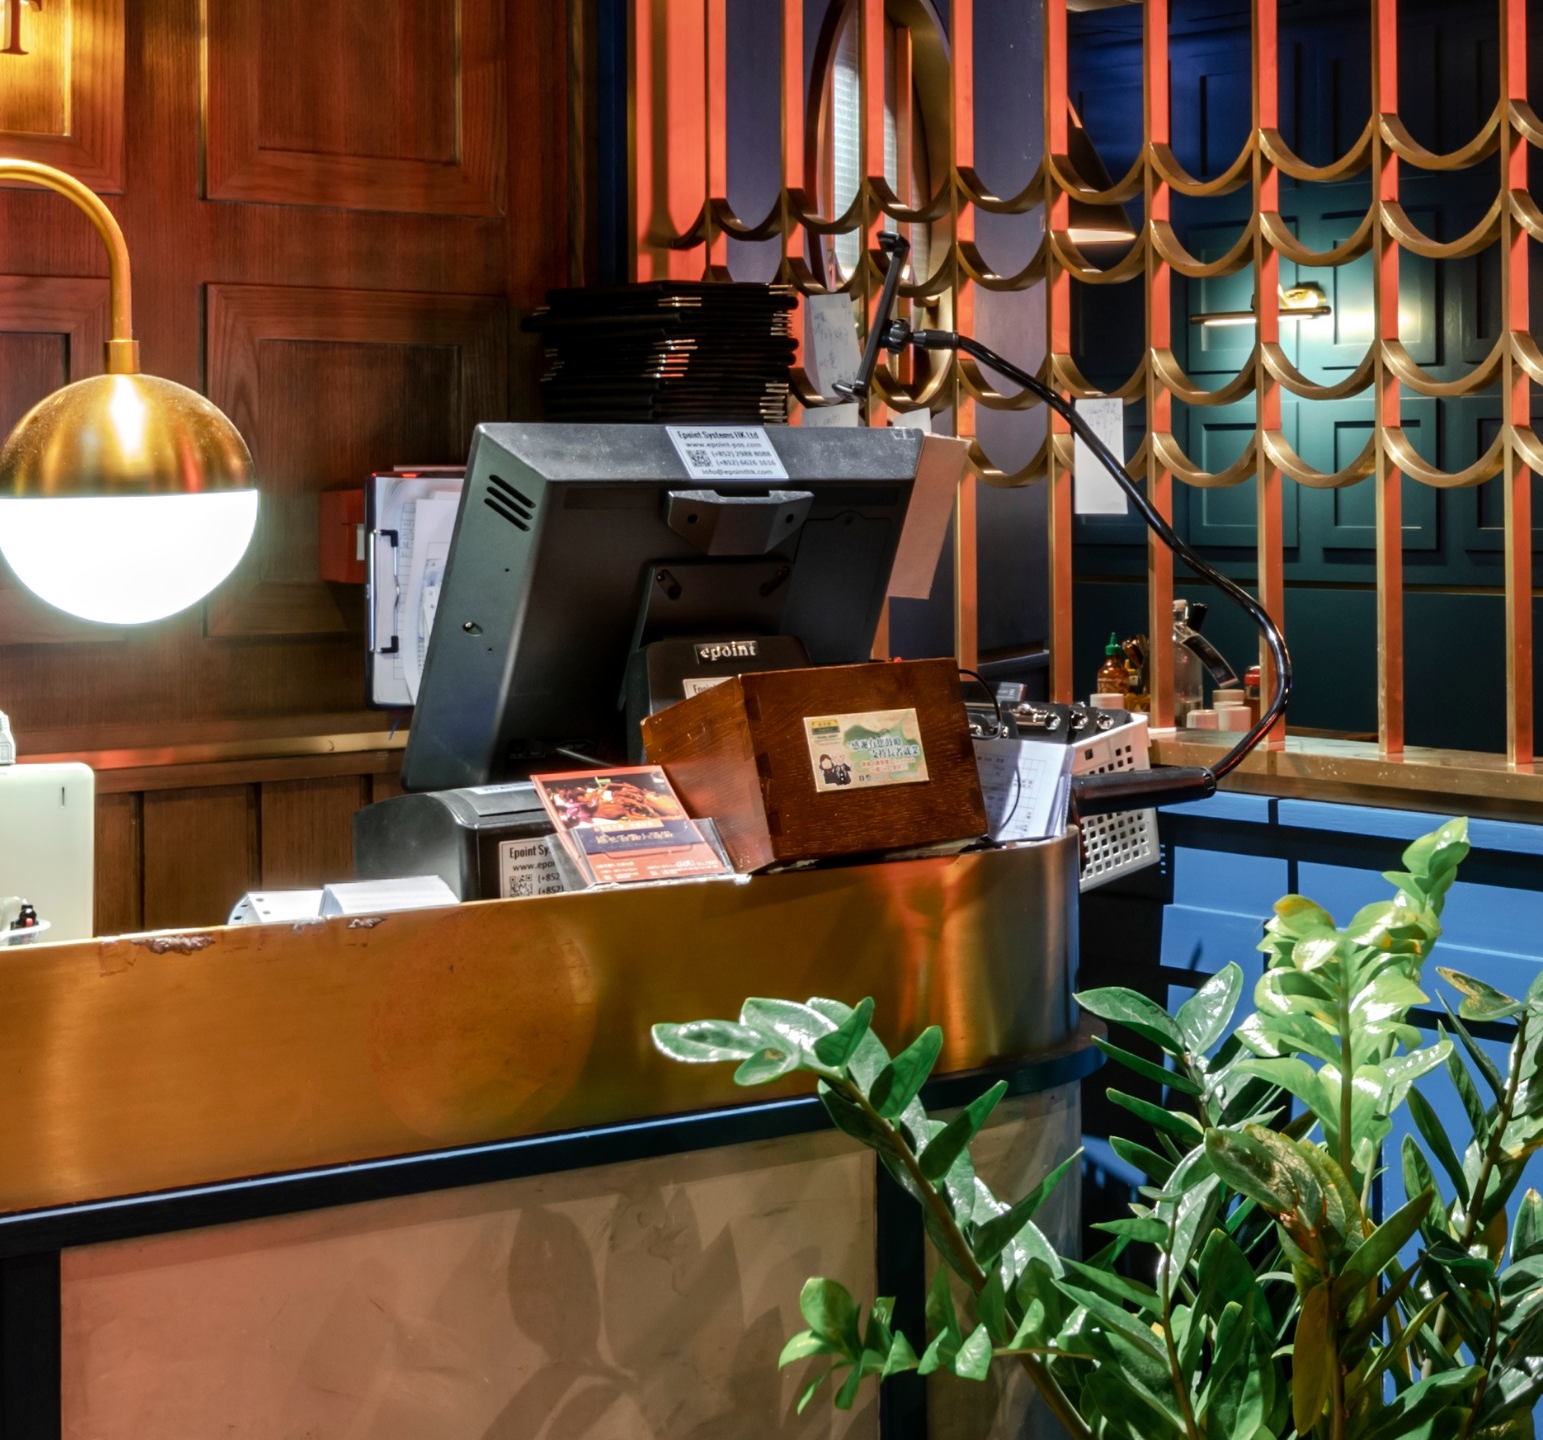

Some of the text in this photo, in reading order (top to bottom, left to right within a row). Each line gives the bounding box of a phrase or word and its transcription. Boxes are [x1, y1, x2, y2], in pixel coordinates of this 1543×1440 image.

[677, 431, 702, 440] Epoint
[702, 431, 734, 440] Systems
[700, 641, 756, 661] epoint
[509, 844, 552, 860] Epoint Sy
